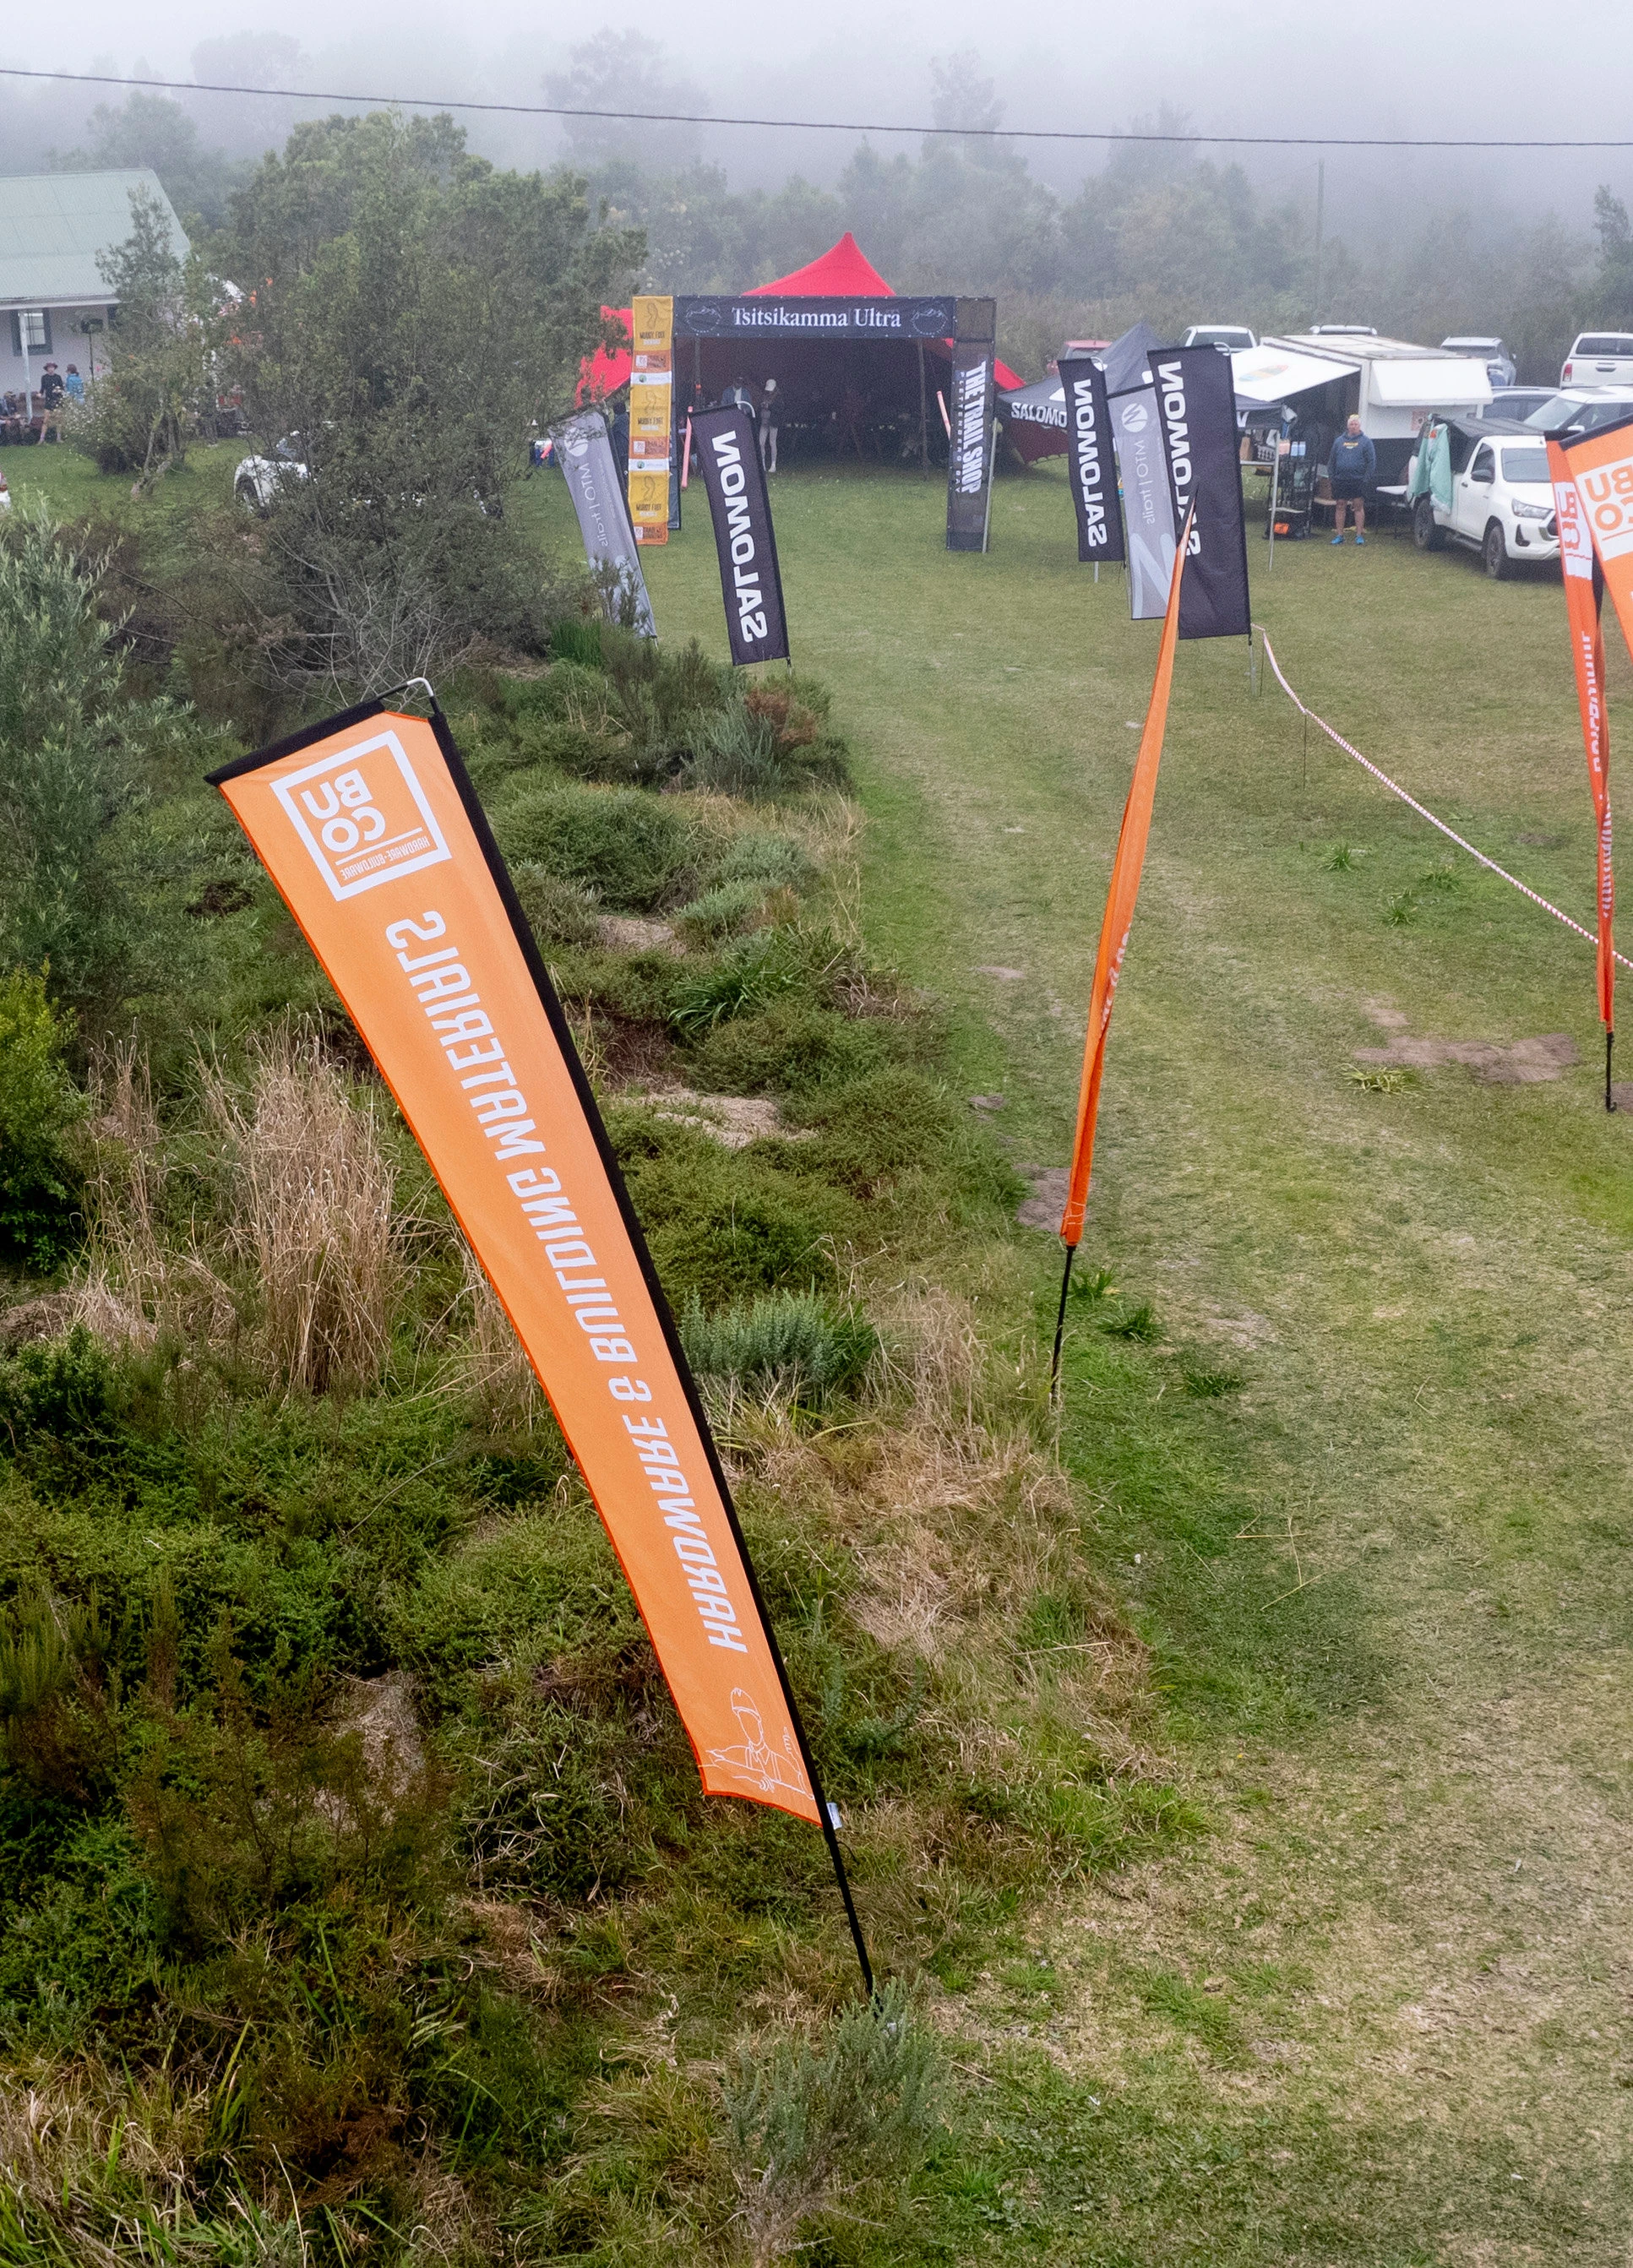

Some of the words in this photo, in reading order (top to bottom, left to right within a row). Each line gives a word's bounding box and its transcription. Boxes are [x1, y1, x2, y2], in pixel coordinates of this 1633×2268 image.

[732, 307, 848, 327] Tsitsikamma
[853, 307, 901, 327] Ultra
[965, 361, 987, 400] THE
[962, 395, 985, 450] TRAIL
[1011, 402, 1068, 428] SALOMO
[961, 446, 983, 494] SHOP
